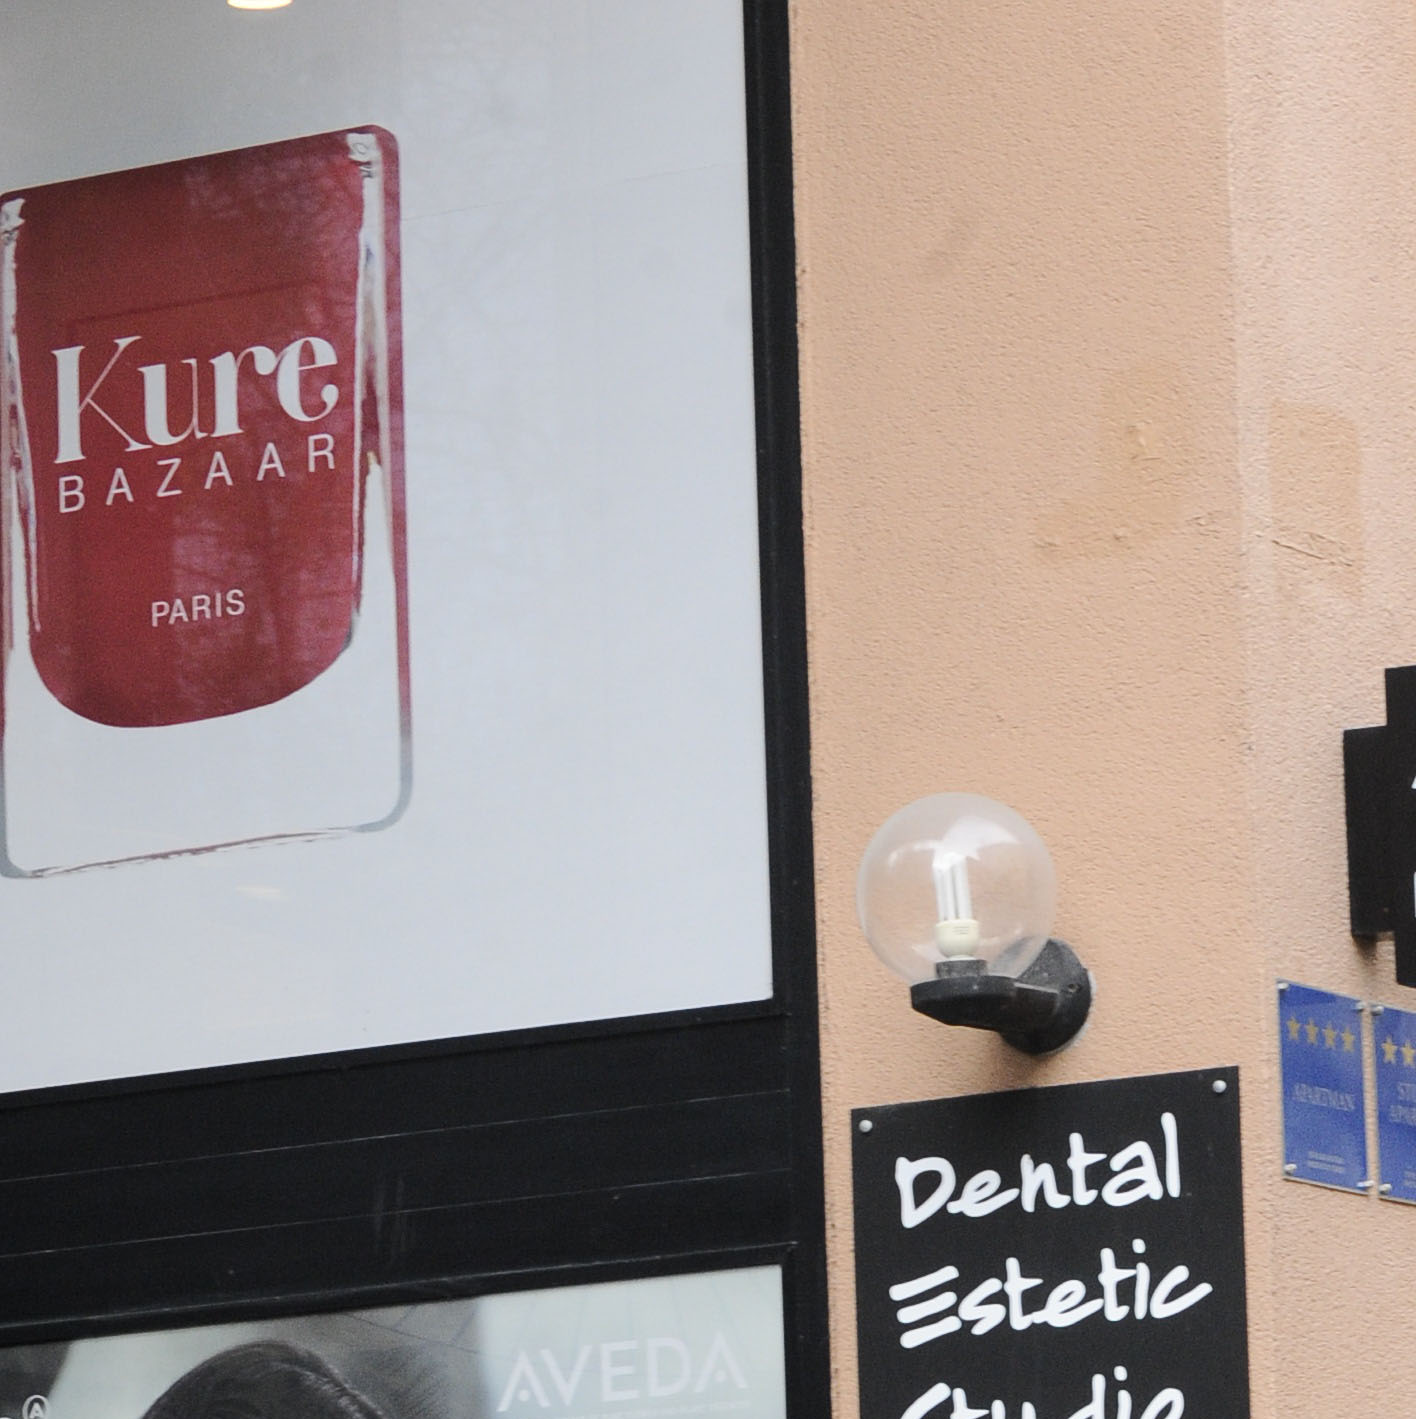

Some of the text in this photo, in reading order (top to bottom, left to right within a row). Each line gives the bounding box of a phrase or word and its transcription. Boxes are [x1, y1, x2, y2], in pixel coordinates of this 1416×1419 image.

[51, 336, 339, 464] Kure
[58, 433, 336, 514] BAZAAR
[151, 589, 245, 627] PARIS
[895, 1112, 1182, 1229] Dental
[888, 1238, 1213, 1349] Estetic
[496, 1330, 750, 1412] AVEDA
